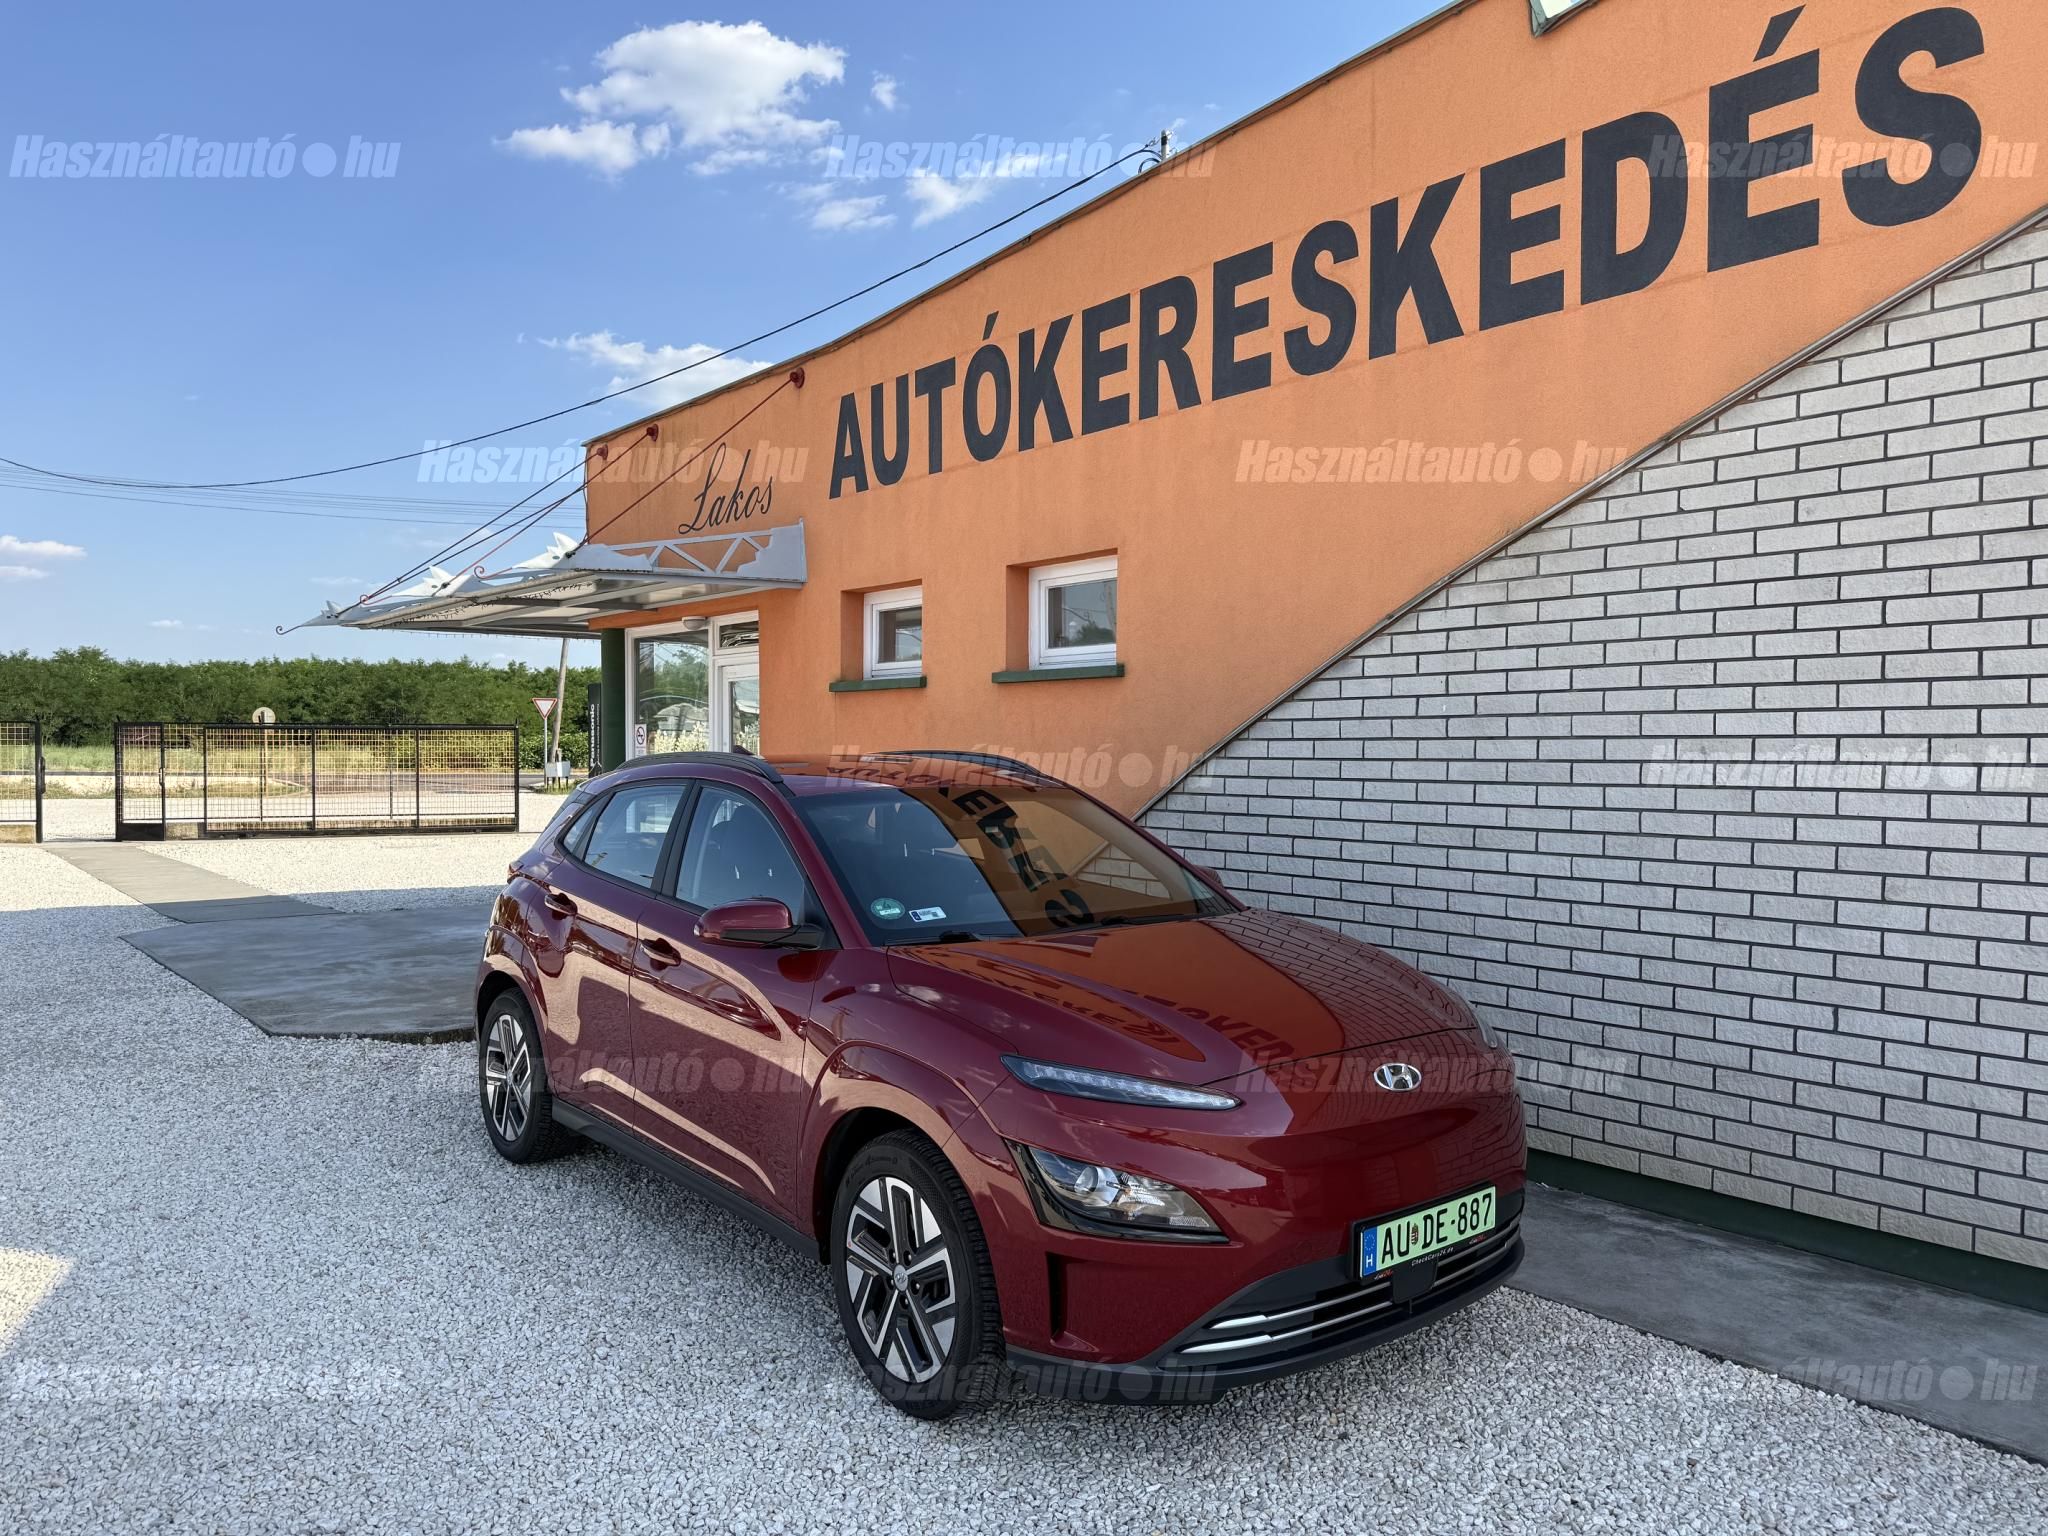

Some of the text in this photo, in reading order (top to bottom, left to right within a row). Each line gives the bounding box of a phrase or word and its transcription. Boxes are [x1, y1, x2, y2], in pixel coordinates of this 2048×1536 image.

[829, 5, 1984, 498] AUTÓKERESKEDÉS
[678, 442, 773, 535] Lakos
[1365, 1255, 1374, 1268] H
[1381, 1220, 1411, 1265] AU
